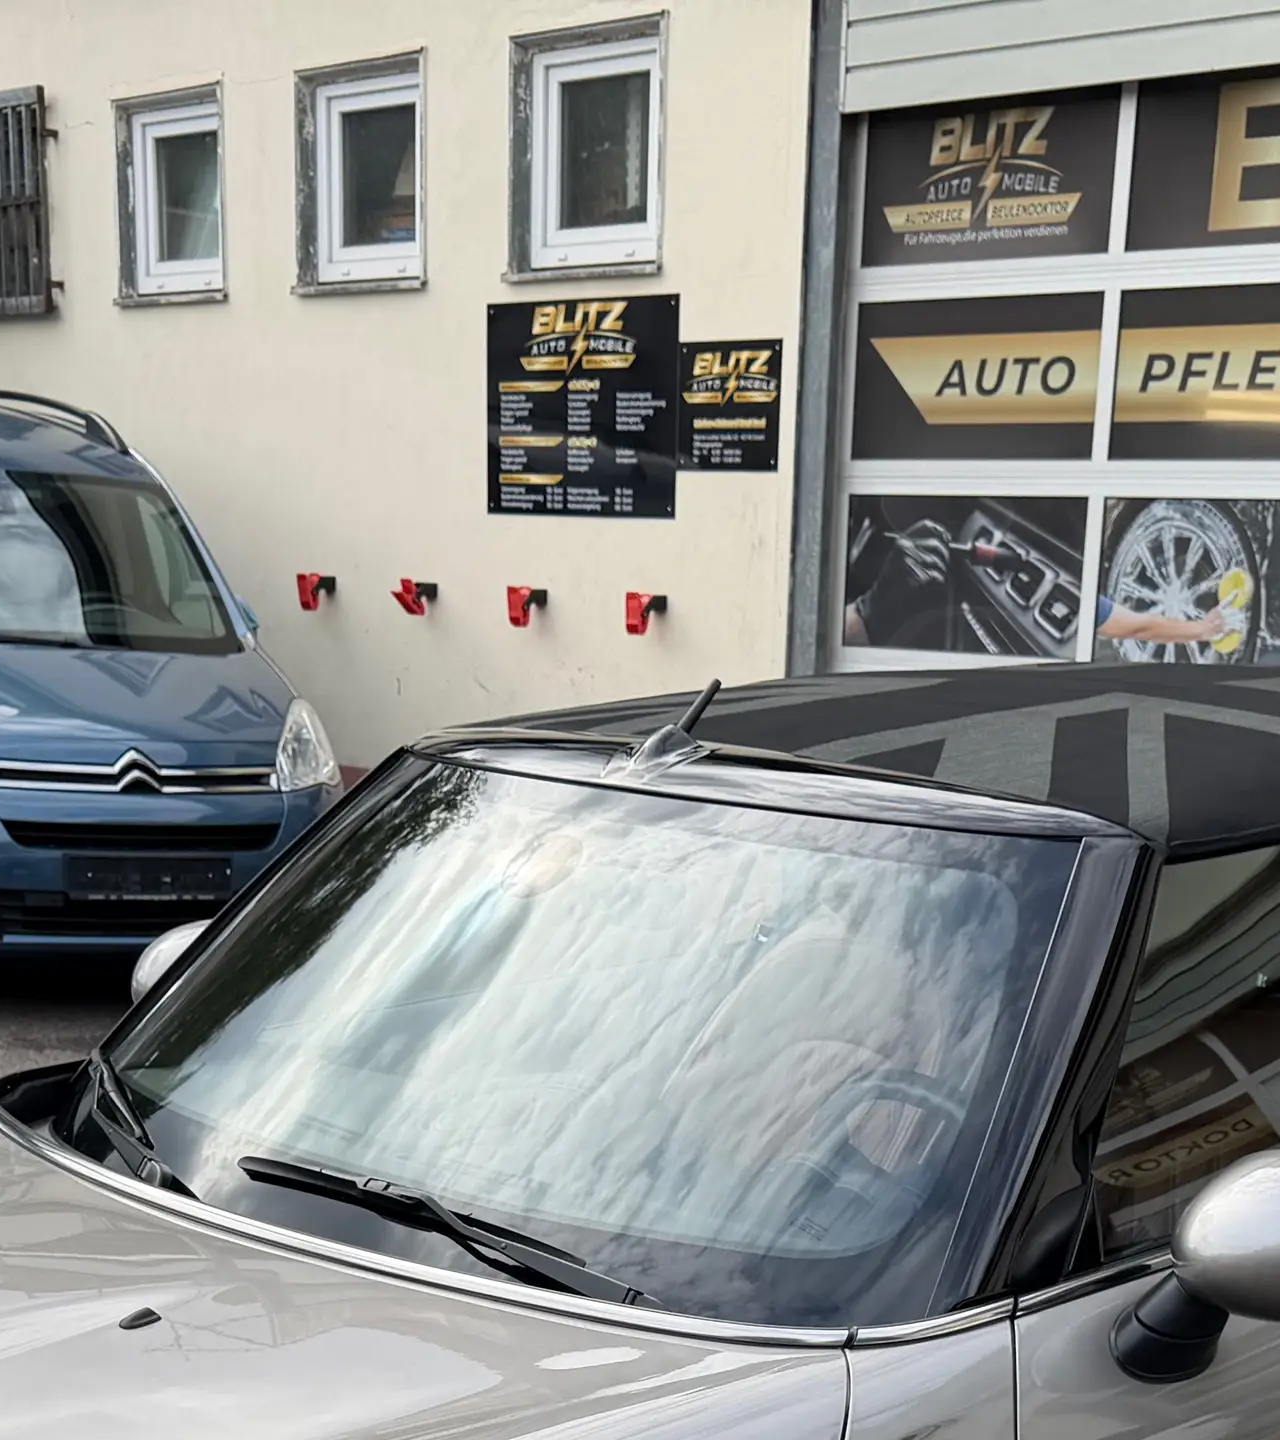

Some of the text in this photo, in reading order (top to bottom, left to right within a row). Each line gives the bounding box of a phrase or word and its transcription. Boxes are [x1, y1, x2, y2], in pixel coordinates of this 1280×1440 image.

[929, 106, 1056, 166] BLITZ
[926, 173, 1060, 203] AUTO MOBILE
[903, 201, 1070, 225] AUTOPFLEGE BEULENDOKTOR
[532, 300, 629, 335] BLITZ
[530, 338, 635, 356] AUTO MOBILE
[693, 350, 773, 376] BLITZ
[935, 354, 1076, 397] AUTO
[692, 378, 777, 392] AUTO MOBILE
